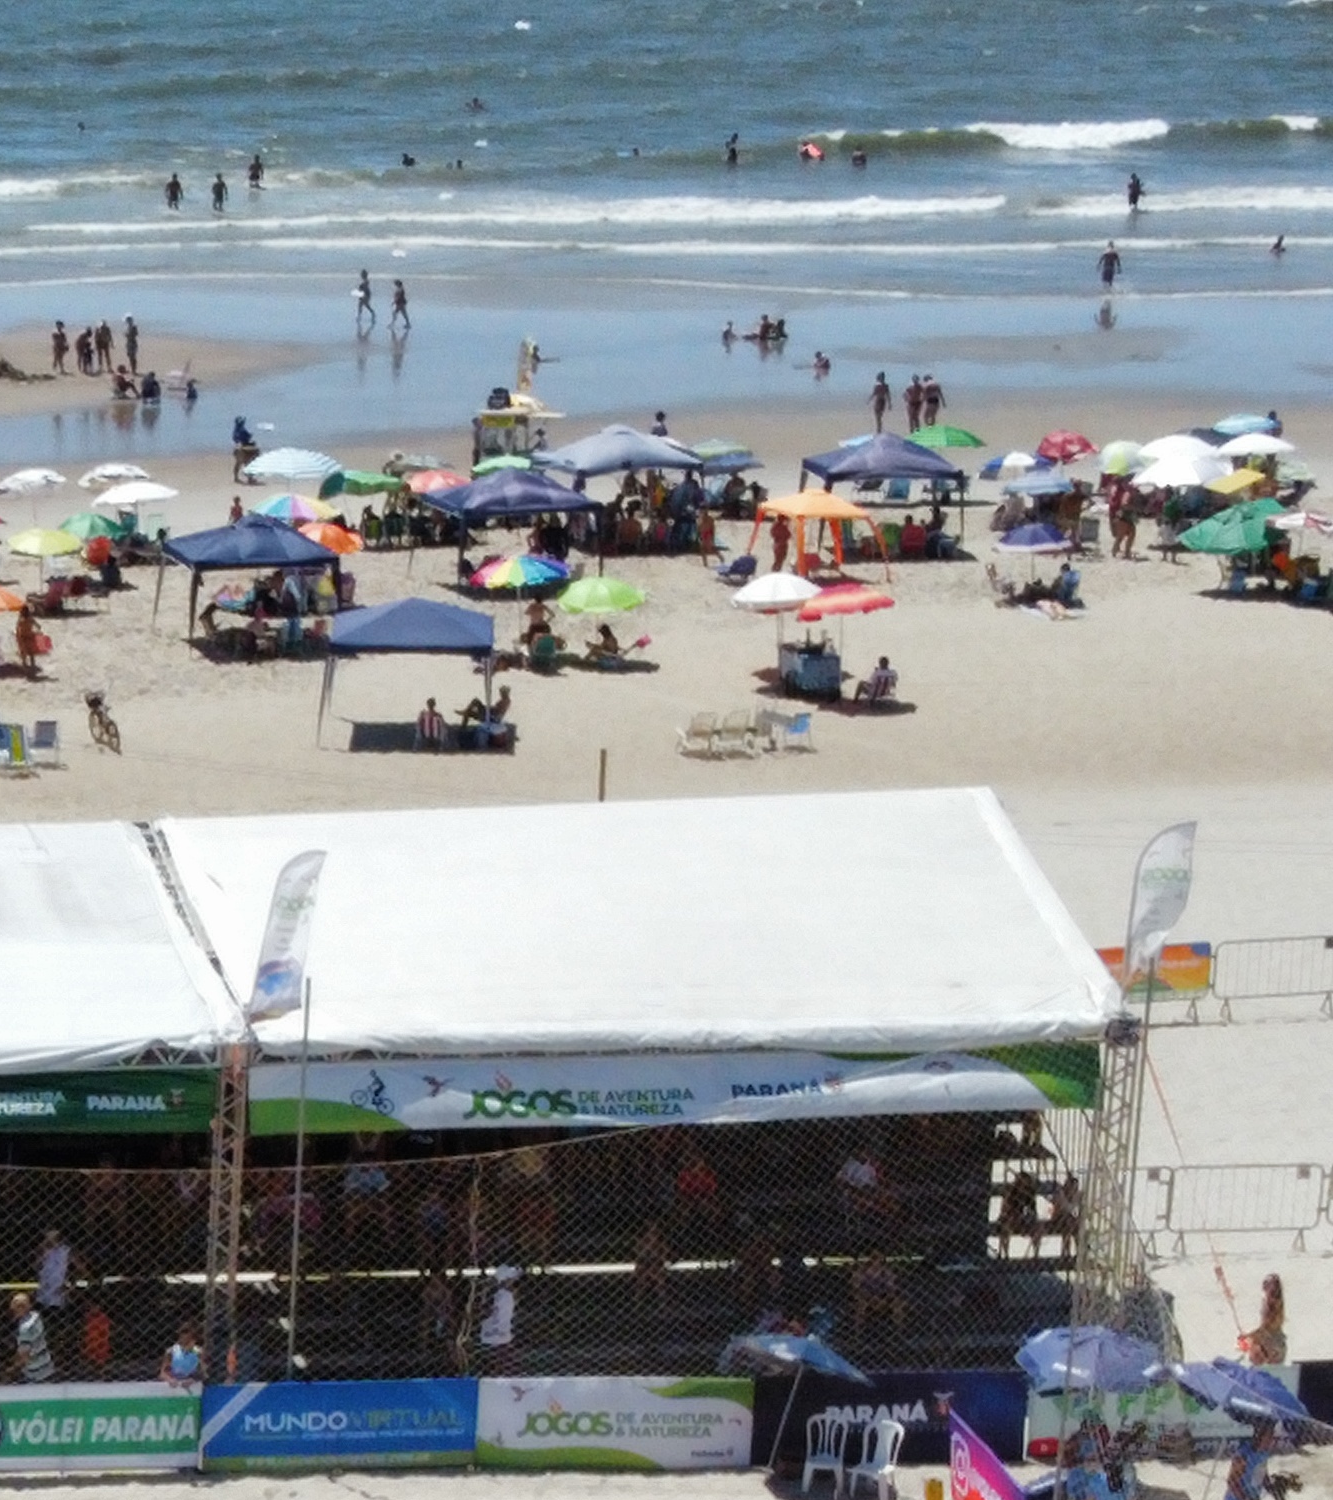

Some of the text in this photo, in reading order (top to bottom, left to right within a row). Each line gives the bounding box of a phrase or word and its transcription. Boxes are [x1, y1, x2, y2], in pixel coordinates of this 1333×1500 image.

[463, 1088, 578, 1120] JOGOS
[606, 1087, 694, 1103] AVENTURA
[593, 1103, 684, 1116] NATUREZA
[8, 1410, 83, 1444] VÔLEI
[90, 1404, 196, 1442] PARANÁ
[244, 1411, 347, 1433] MUNDO
[517, 1410, 614, 1438] JOGOS
[615, 1411, 724, 1426] DE AVENTURA
[632, 1425, 712, 1439] NATUREZA
